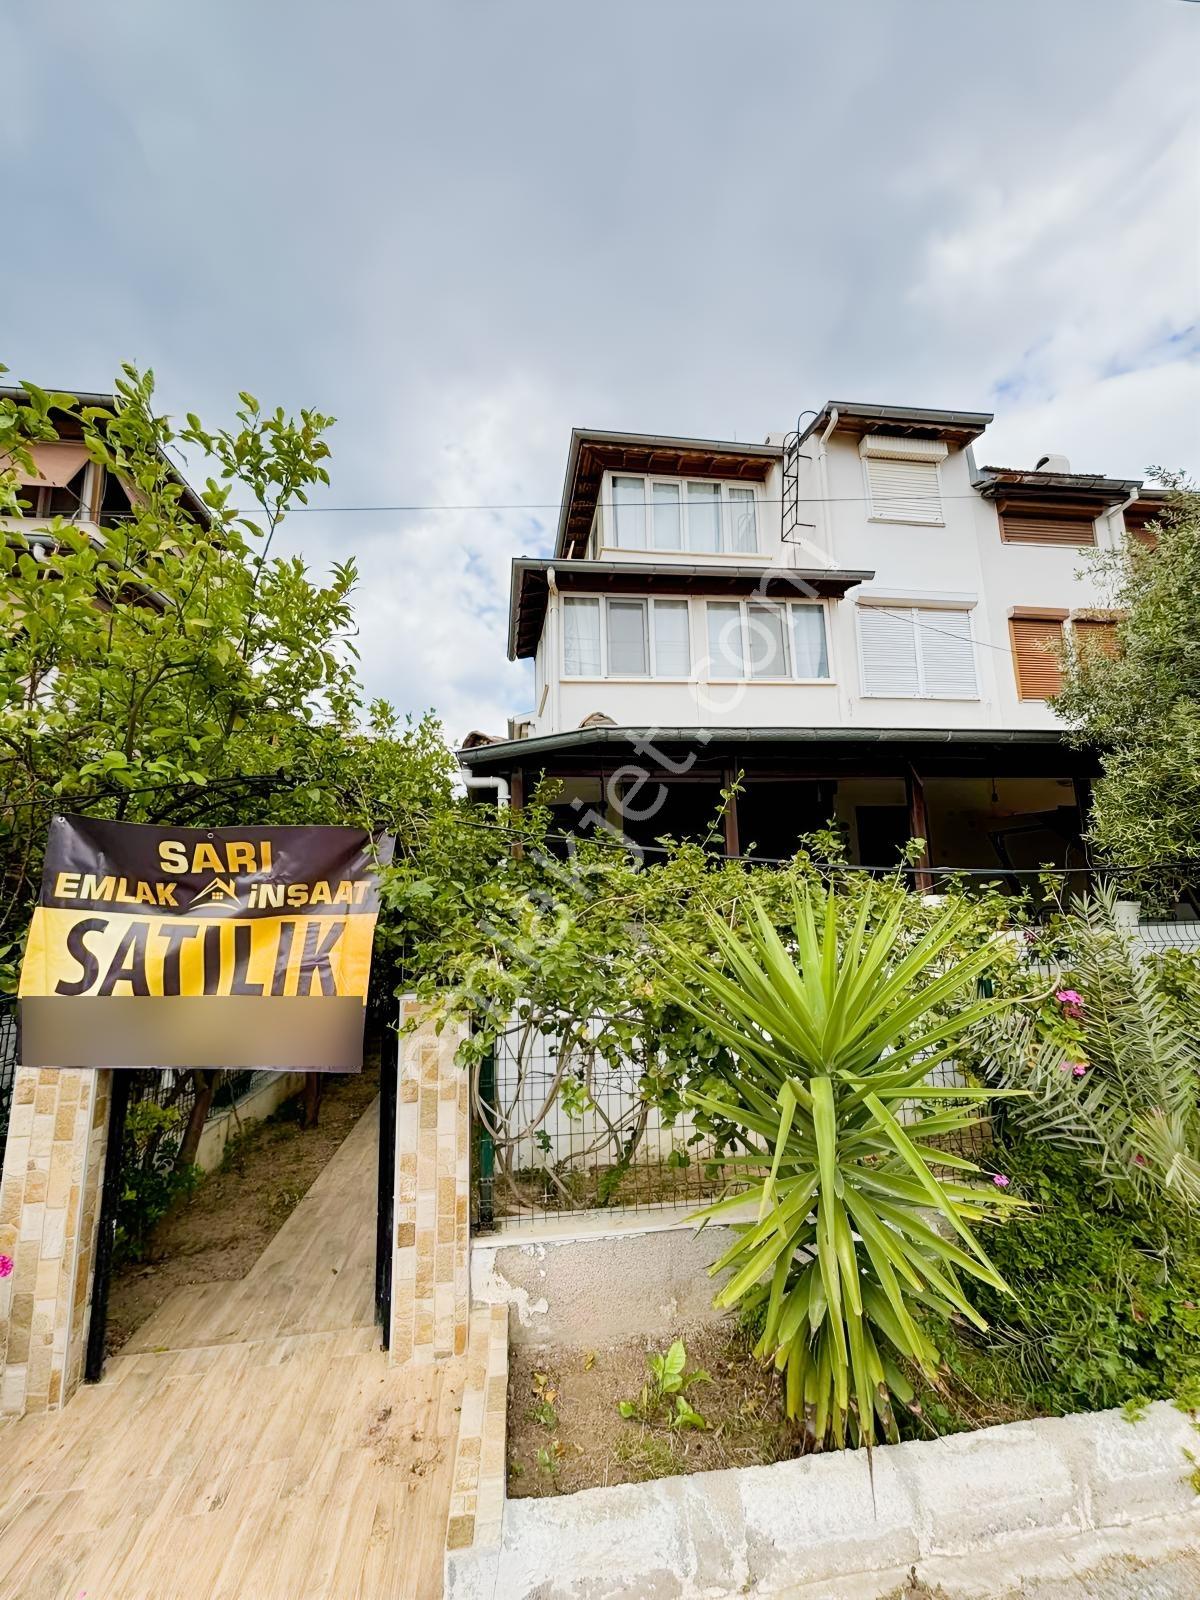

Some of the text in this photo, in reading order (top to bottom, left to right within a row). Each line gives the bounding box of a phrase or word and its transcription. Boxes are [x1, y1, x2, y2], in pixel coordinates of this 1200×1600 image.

[158, 840, 273, 874] SARI
[54, 872, 179, 907] EMLAK
[54, 917, 346, 996] SATILIK
